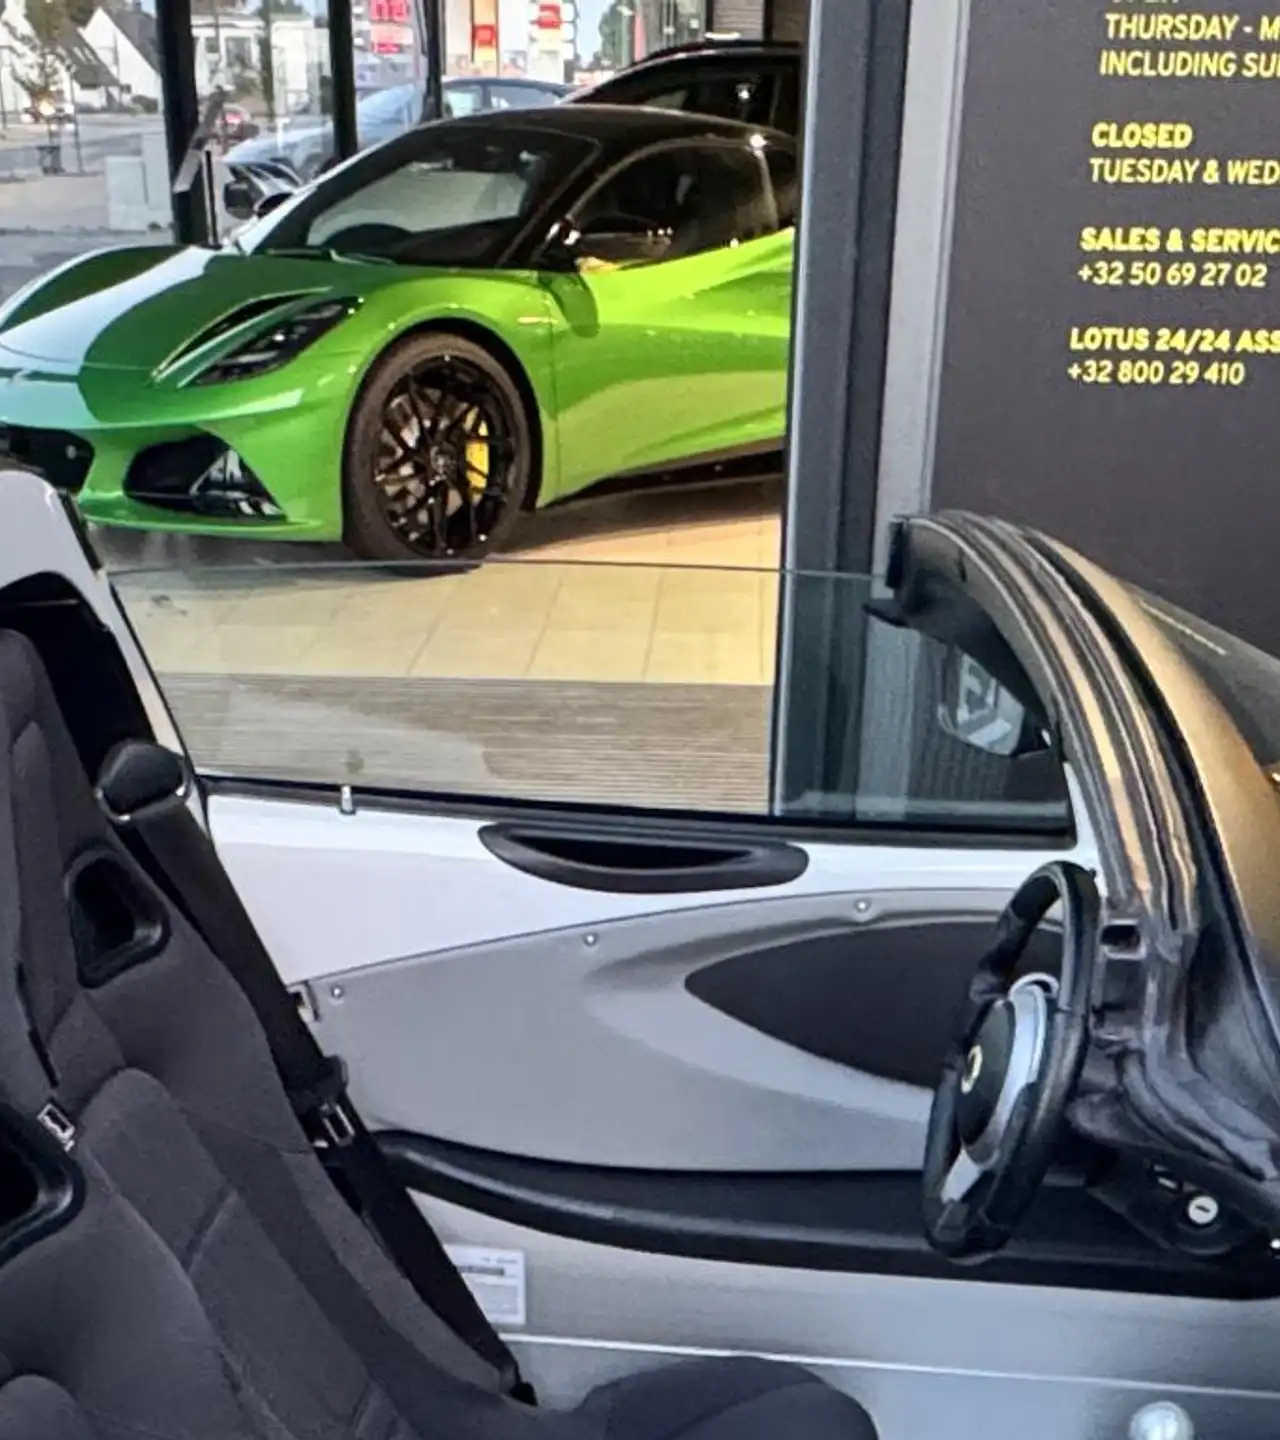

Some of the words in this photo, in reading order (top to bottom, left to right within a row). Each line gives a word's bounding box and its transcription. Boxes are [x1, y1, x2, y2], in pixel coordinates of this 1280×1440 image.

[1105, 13, 1240, 40] THURSDAY
[1100, 50, 1237, 77] INCLUDING
[1092, 122, 1192, 149] CLOSED
[1090, 158, 1200, 184] TUESDAY
[1203, 159, 1219, 184] &
[1080, 227, 1160, 252] SALES
[1166, 228, 1183, 252] &
[1078, 261, 1124, 285] +32
[1129, 262, 1161, 285] 50
[1166, 262, 1196, 285] 69
[1200, 262, 1232, 286] 27
[1235, 263, 1267, 287] 02
[1070, 327, 1149, 351] LOTUS
[1155, 328, 1231, 355] 24/24
[1068, 360, 1113, 382] +32
[1118, 360, 1164, 384] 800
[1169, 361, 1199, 384] 29
[1204, 362, 1245, 385] 410
